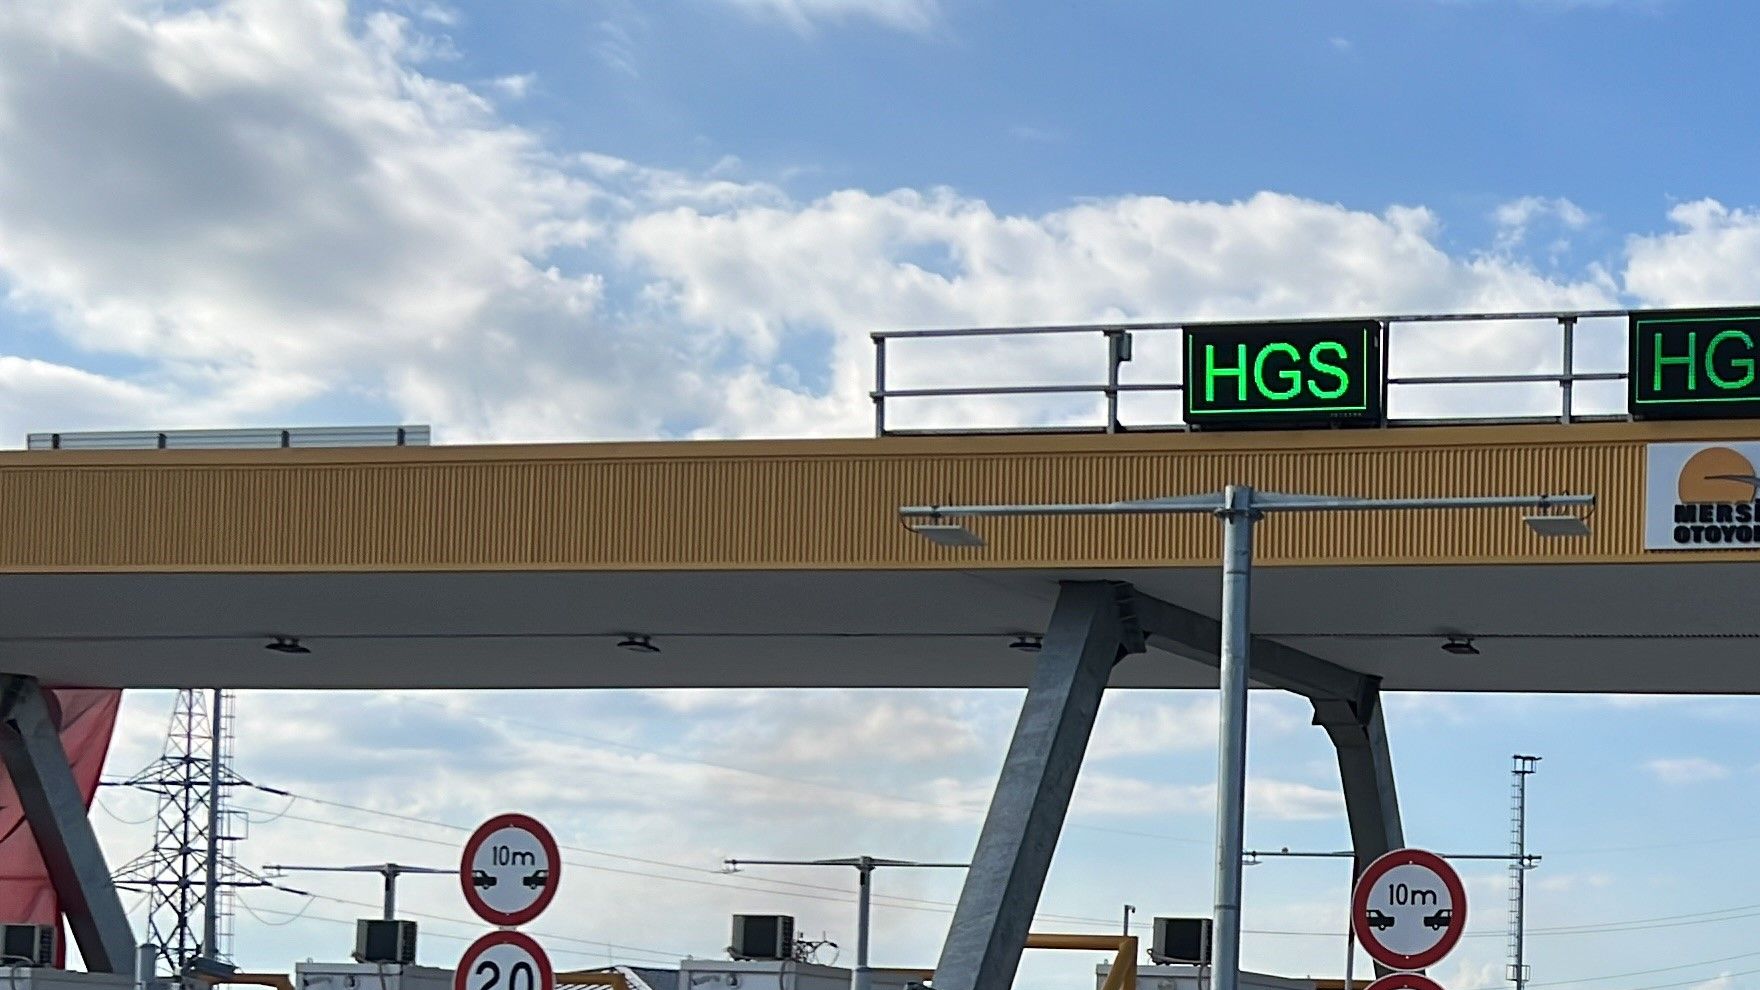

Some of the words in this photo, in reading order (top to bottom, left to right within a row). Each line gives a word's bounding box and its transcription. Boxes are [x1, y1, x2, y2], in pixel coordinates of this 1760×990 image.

[1205, 341, 1349, 402] HGS
[492, 845, 536, 866] 10m
[1389, 883, 1437, 906] 10m
